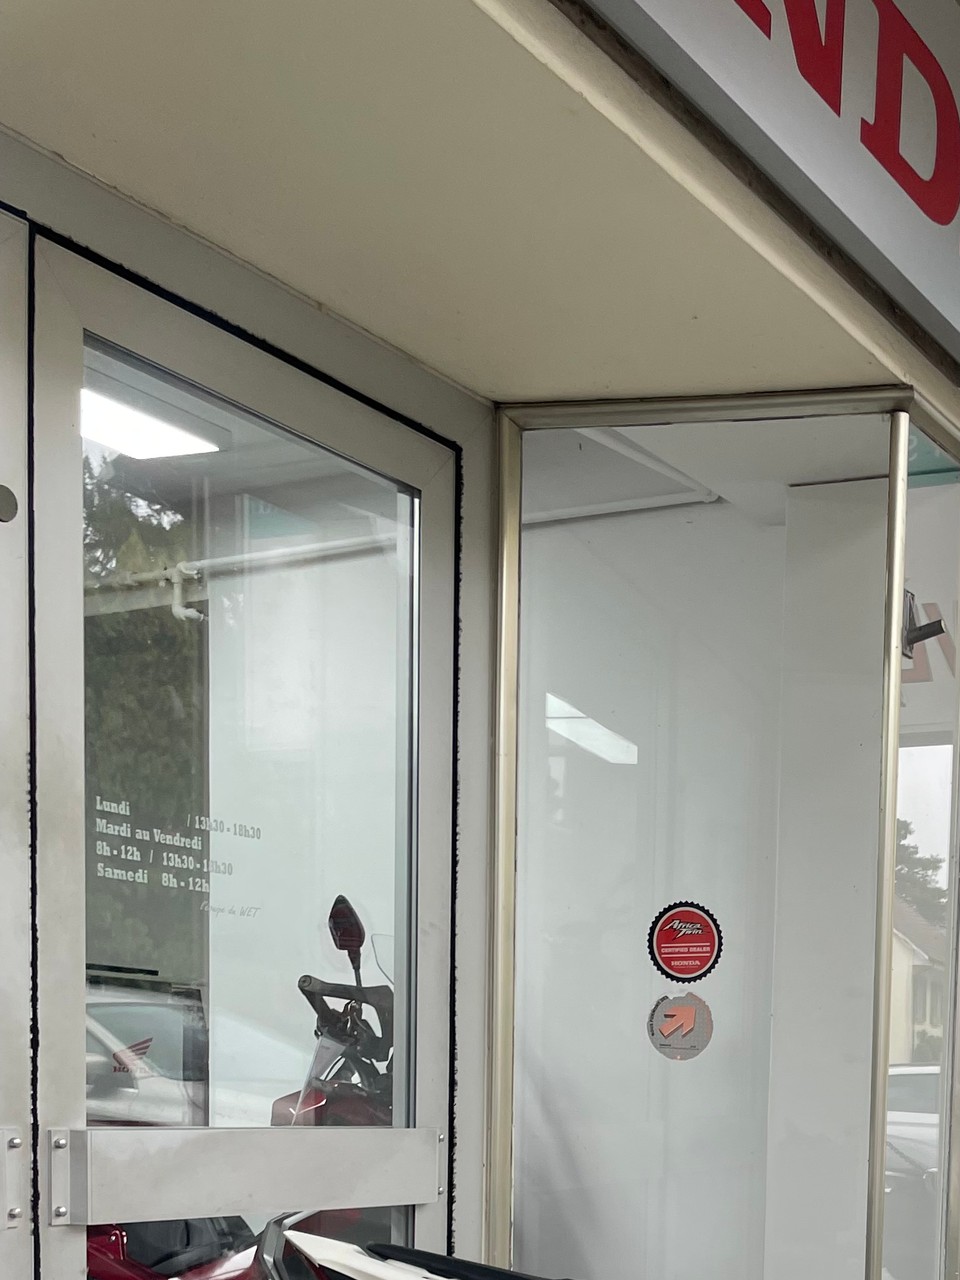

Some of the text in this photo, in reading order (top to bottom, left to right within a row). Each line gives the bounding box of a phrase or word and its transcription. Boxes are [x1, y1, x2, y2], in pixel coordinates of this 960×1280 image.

[96, 796, 131, 816] Lundi
[96, 818, 202, 850] Mardi au Vendredi
[97, 862, 148, 884] Samedi
[662, 919, 702, 931] Africa
[675, 928, 703, 939] Twin
